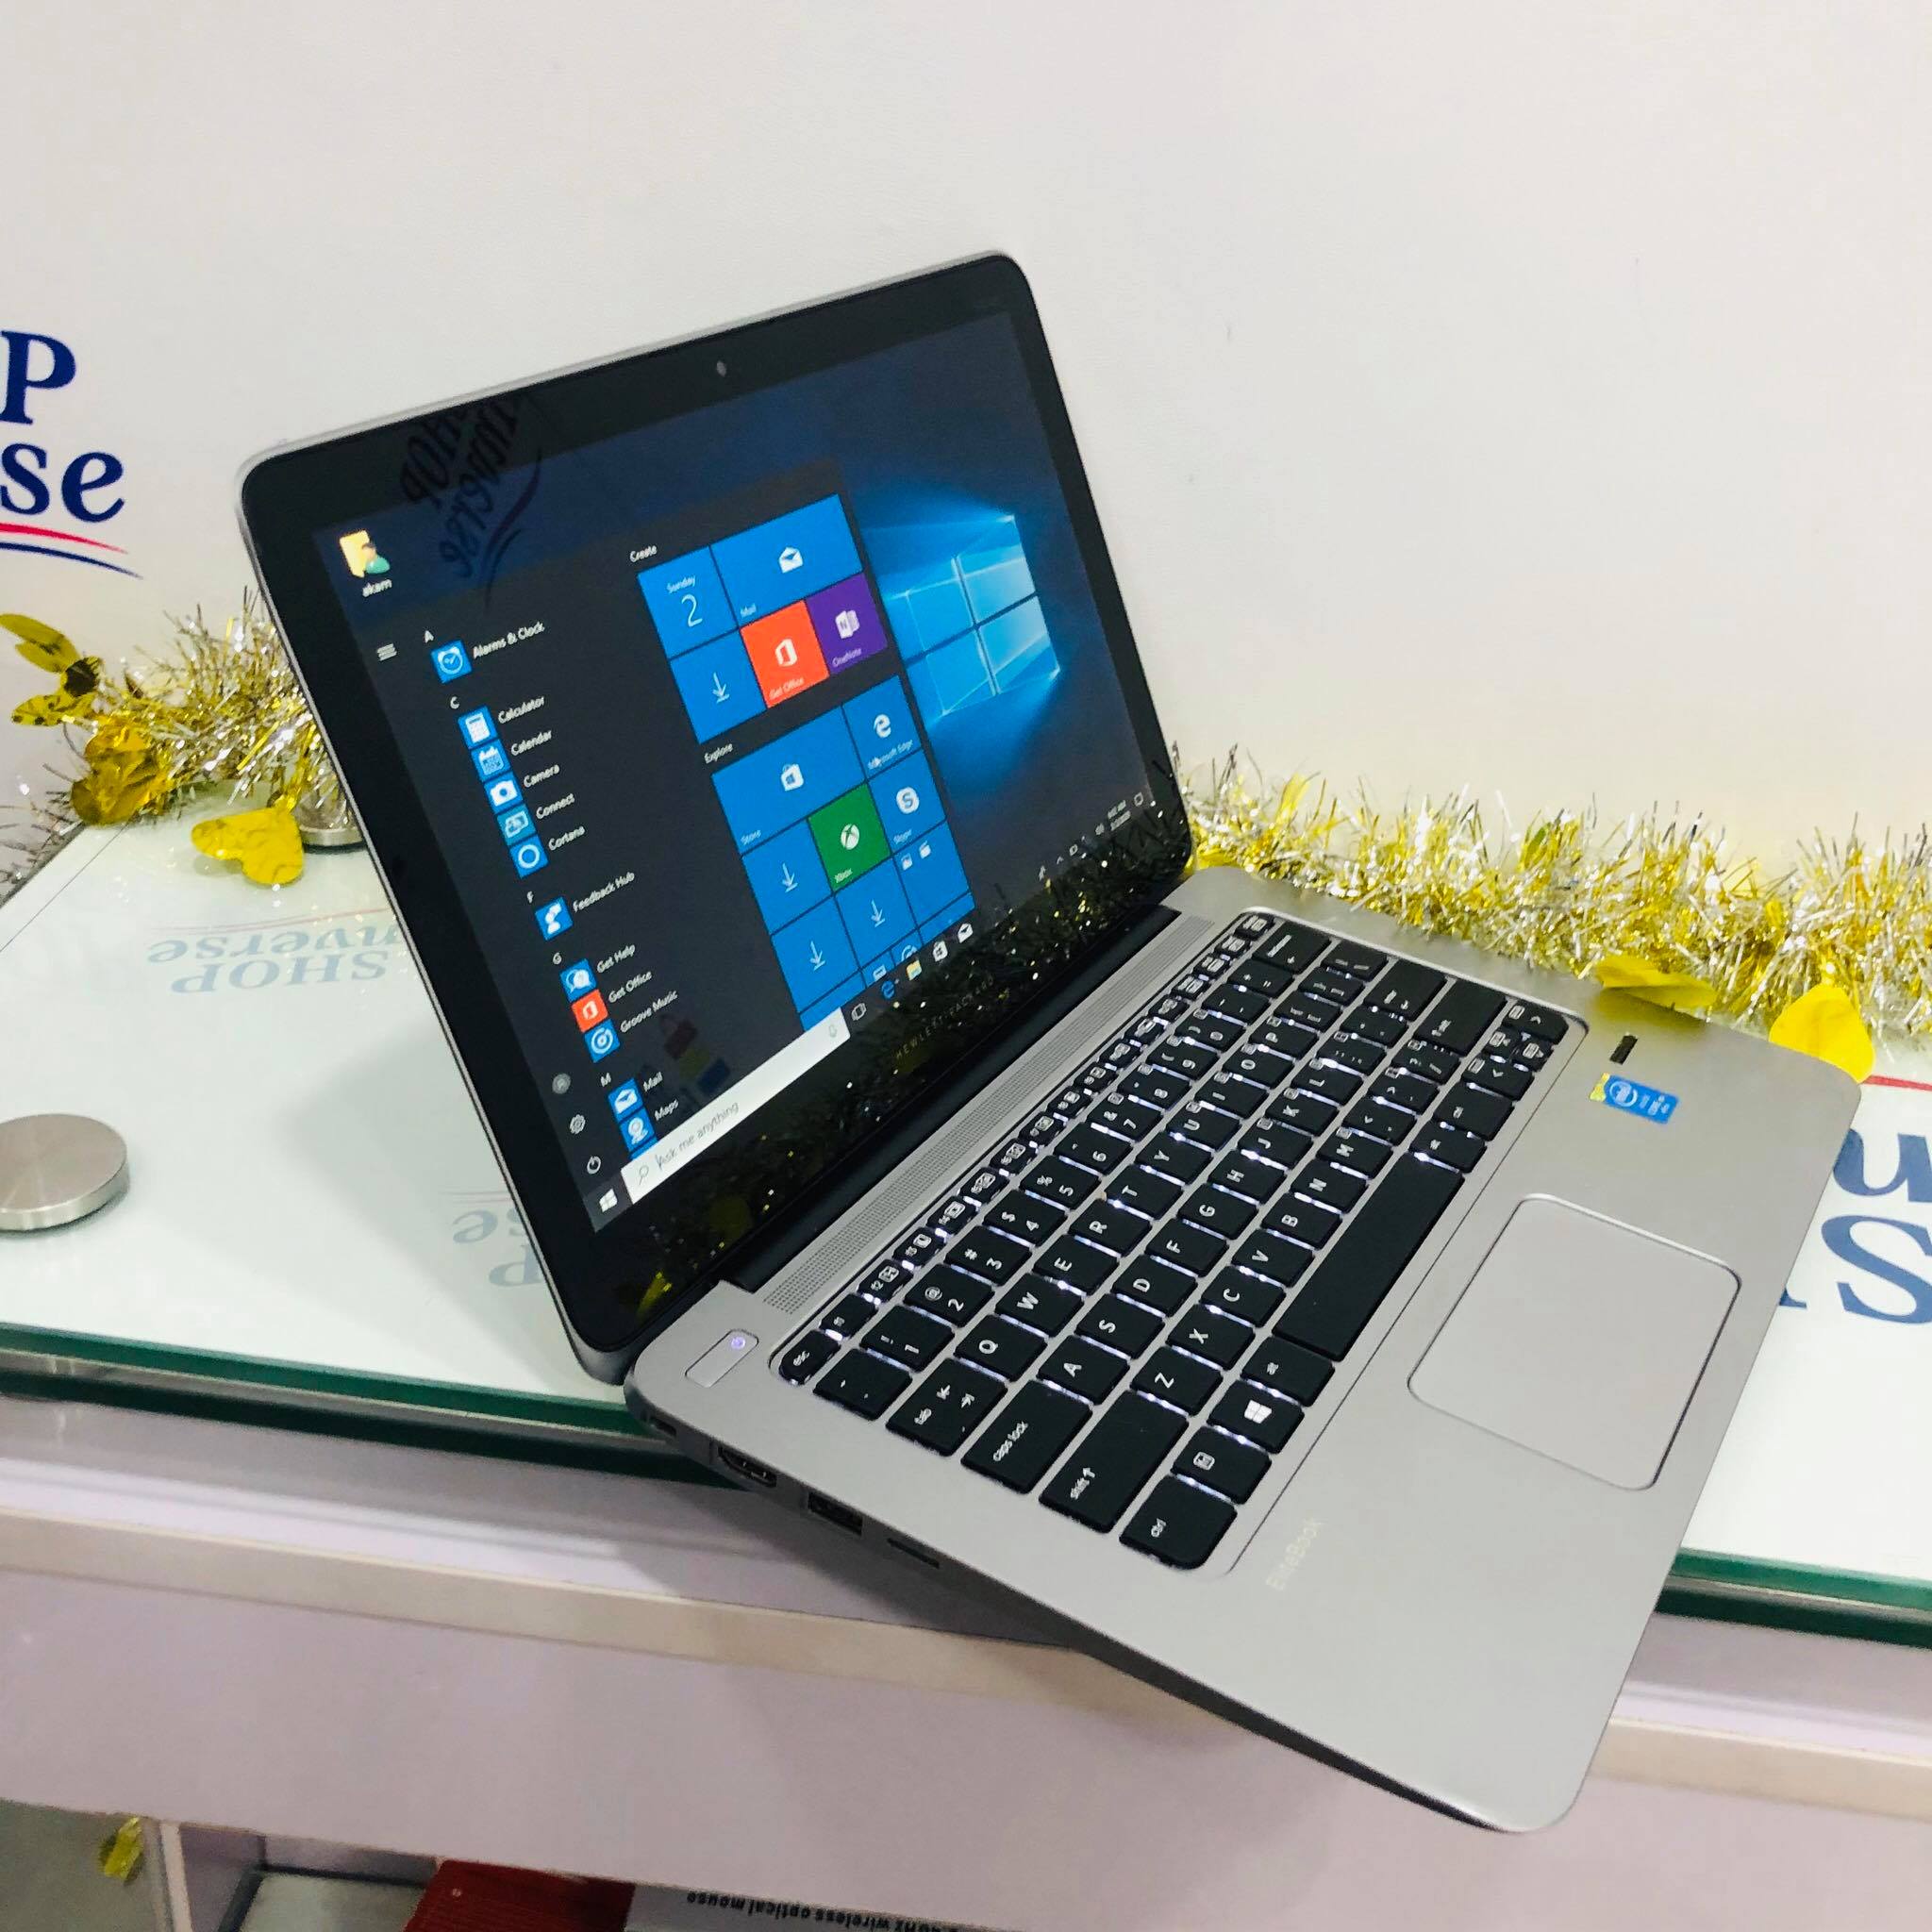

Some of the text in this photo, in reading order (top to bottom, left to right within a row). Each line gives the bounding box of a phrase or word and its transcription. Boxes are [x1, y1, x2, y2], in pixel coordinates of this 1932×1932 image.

[630, 545, 658, 563] Create
[667, 575, 696, 594] Sunday
[681, 594, 702, 627] 2
[425, 630, 434, 643] A
[474, 621, 545, 659] Alarms & Clock
[450, 697, 459, 709] C
[498, 696, 544, 724] Calculator
[511, 730, 552, 756] Calendar
[705, 743, 733, 764] Explore
[524, 764, 559, 787] Camera
[536, 793, 575, 819] Connect
[549, 826, 585, 850] Cortana
[741, 830, 761, 845] Store
[574, 872, 635, 912] Feedback Hub
[147, 924, 400, 965] nverse
[597, 944, 636, 974] Get Help
[170, 949, 389, 994] SHOP
[608, 972, 652, 1003] Get Office
[621, 991, 678, 1033] Groove Music
[1209, 1030, 1223, 1041] 0
[1182, 1058, 1196, 1070] 9
[1241, 1058, 1256, 1070] O
[601, 1072, 611, 1087] M
[643, 1072, 663, 1091] Mail
[1308, 1077, 1325, 1087] L
[1154, 1089, 1168, 1099] 8
[1212, 1091, 1225, 1101] I
[655, 1099, 679, 1121] Maps
[1103, 1111, 1118, 1121] &
[1283, 1106, 1300, 1117] K
[1124, 1119, 1137, 1130] 7
[1183, 1119, 1200, 1130] U
[657, 1102, 739, 1169] Ask me anything
[1257, 1138, 1272, 1149] J
[1336, 1143, 1355, 1158] M
[1092, 1150, 1107, 1162] 6
[1154, 1150, 1170, 1162] Y
[1037, 1175, 1053, 1187] %
[1226, 1169, 1245, 1183] H
[1058, 1185, 1074, 1196] 5
[1122, 1185, 1138, 1197] T
[1308, 1177, 1327, 1192] N
[1001, 1212, 1015, 1223] $
[1198, 1204, 1215, 1217] G
[1026, 1220, 1040, 1232] 4
[1089, 1220, 1108, 1234] R
[1281, 1214, 1298, 1227] B
[964, 1248, 977, 1260] #
[1166, 1240, 1181, 1254] F
[987, 1257, 1002, 1270] 3
[1251, 1249, 1270, 1263] V
[1054, 1257, 1072, 1272] E
[1132, 1277, 1151, 1292] D
[924, 1286, 942, 1301] @
[1017, 1291, 1040, 1311] W
[1223, 1288, 1241, 1303] C
[948, 1298, 964, 1311] 2
[1098, 1319, 1117, 1334] S
[1189, 1328, 1209, 1344] X
[905, 1344, 919, 1354] 1
[978, 1340, 998, 1355] Q
[793, 1351, 809, 1366] esc
[1063, 1361, 1082, 1377] A
[1155, 1372, 1175, 1389] Z
[914, 1407, 932, 1424] tab
[993, 1421, 1029, 1461] caps lock
[1070, 1475, 1090, 1500] shift
[686, 1890, 745, 1911] mouse
